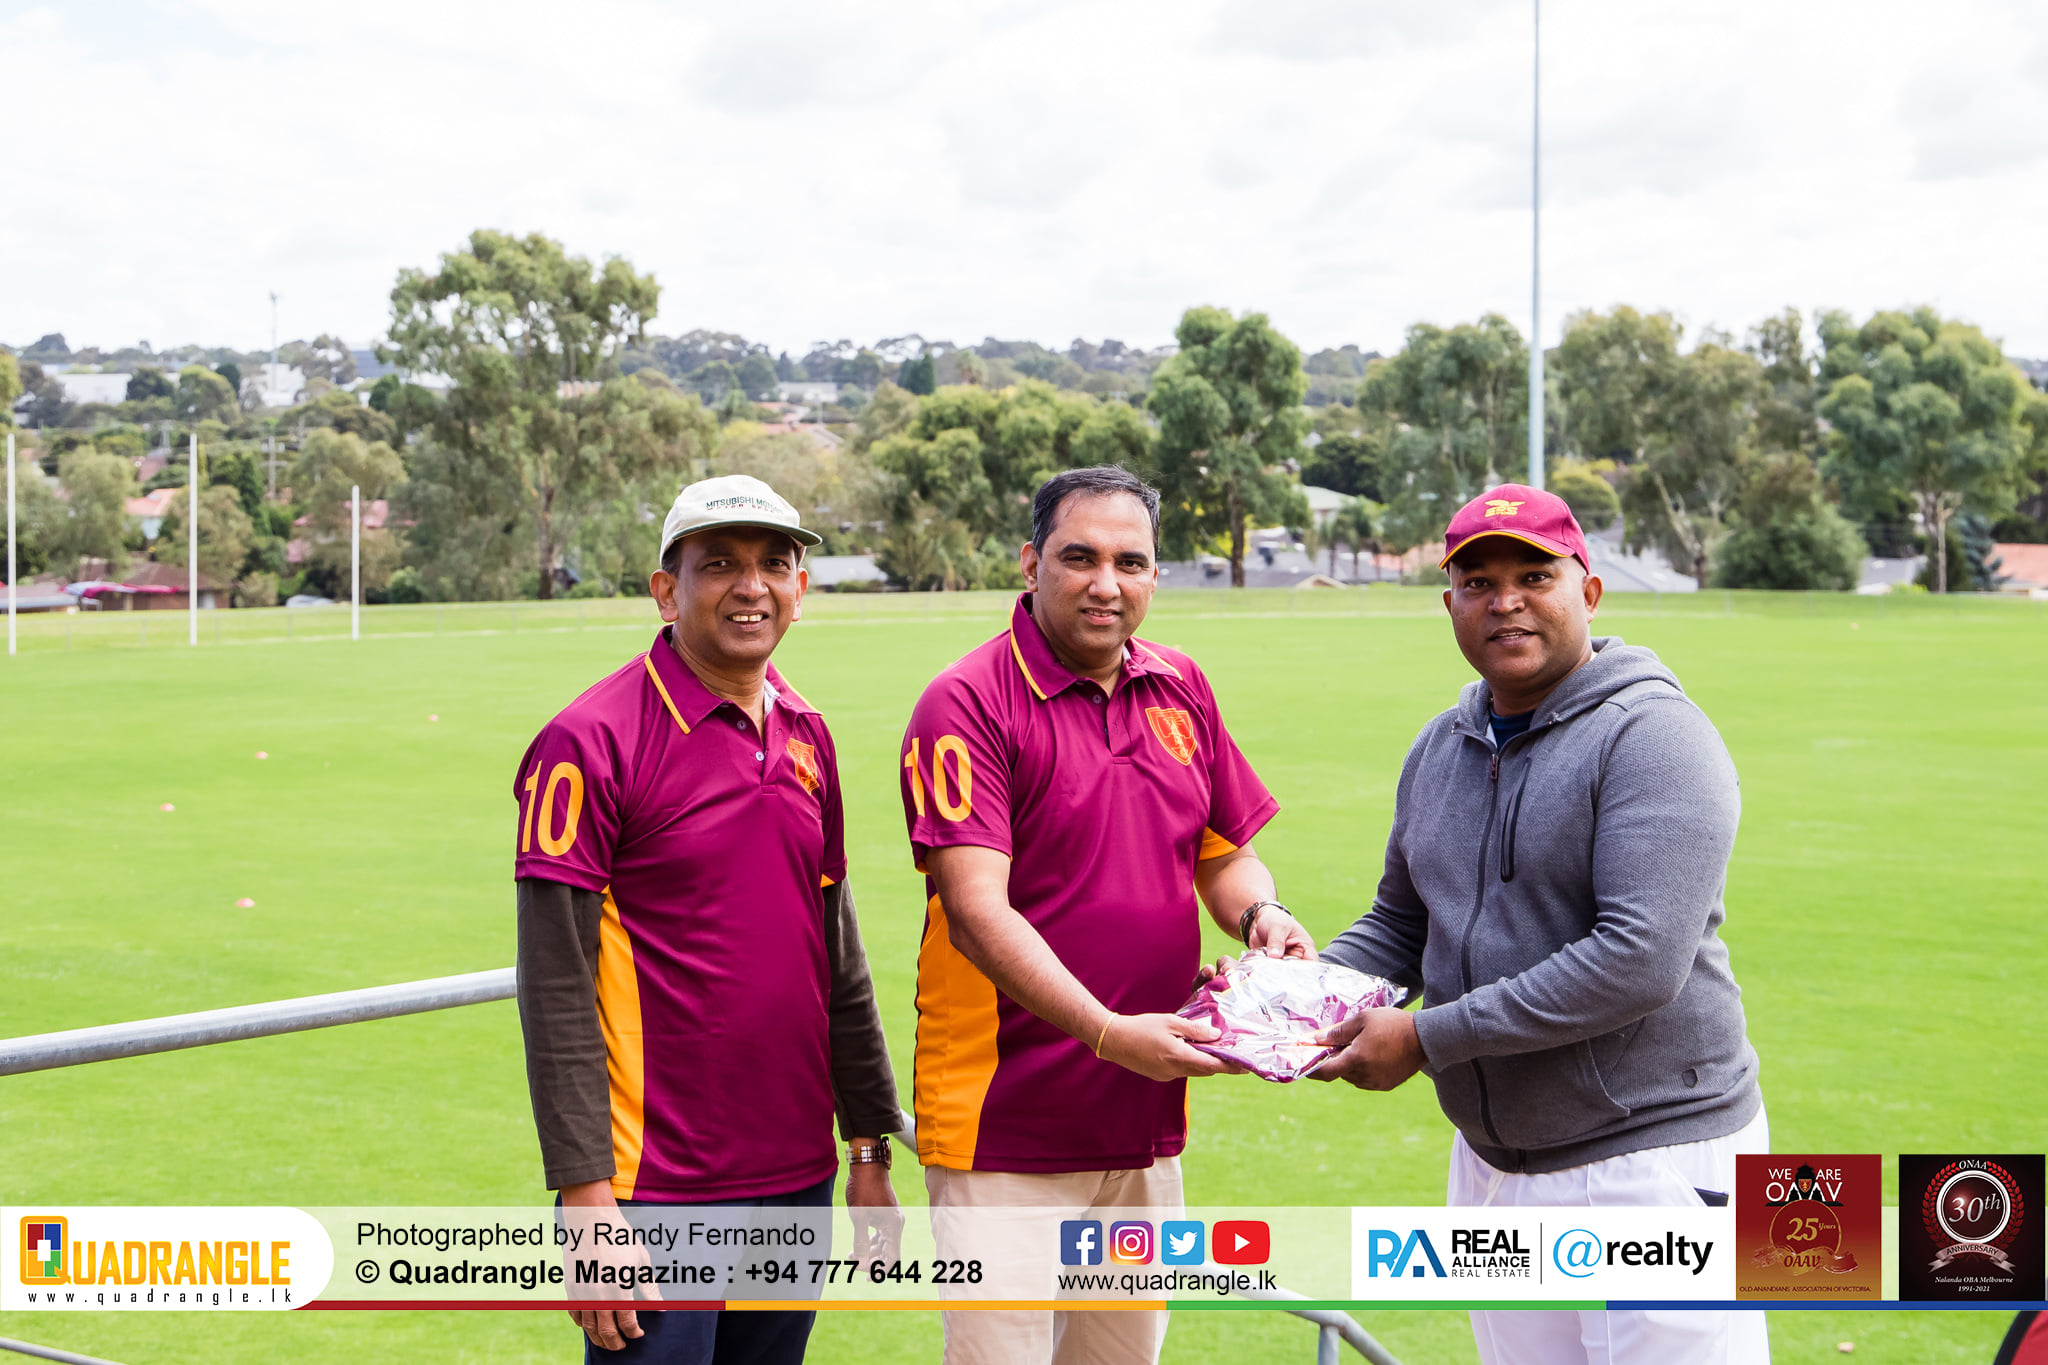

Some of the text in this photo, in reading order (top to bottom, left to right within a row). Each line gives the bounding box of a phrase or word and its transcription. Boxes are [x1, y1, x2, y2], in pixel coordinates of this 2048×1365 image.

[706, 496, 754, 508] MITSUBISHI
[521, 760, 584, 856] 10
[905, 734, 972, 822] 10
